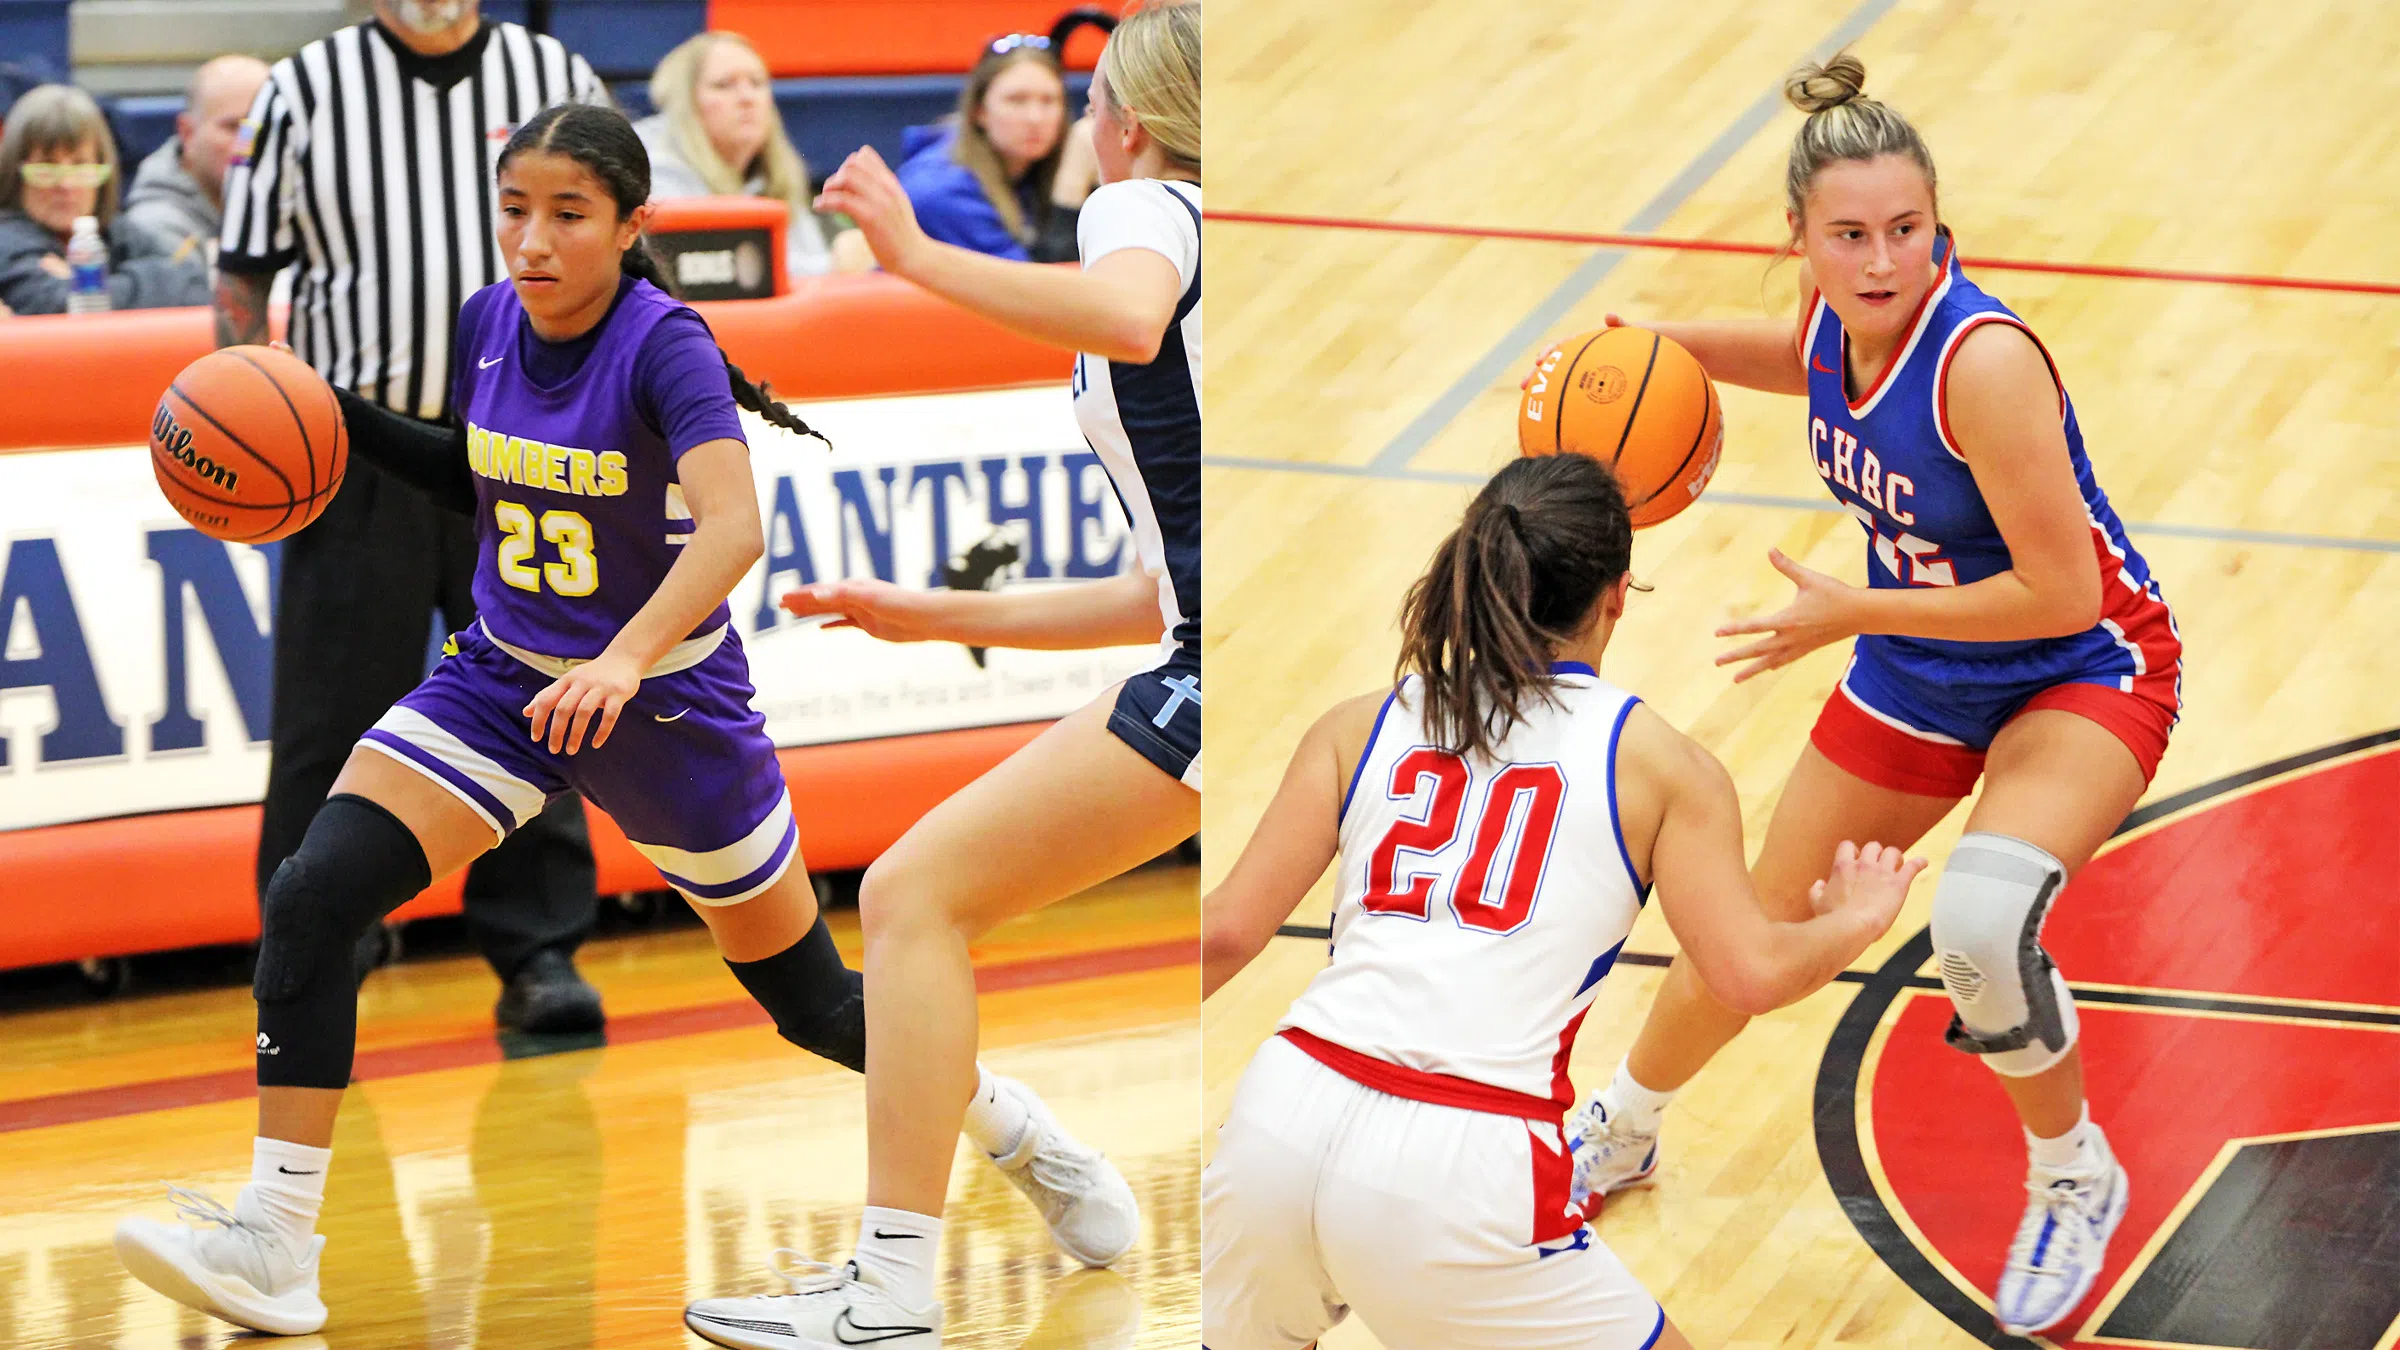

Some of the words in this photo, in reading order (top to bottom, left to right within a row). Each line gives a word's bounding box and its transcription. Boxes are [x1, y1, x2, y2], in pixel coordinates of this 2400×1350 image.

[153, 401, 239, 494] Wilson
[1811, 416, 1915, 526] CHBC
[495, 500, 599, 596] 23
[1358, 745, 1569, 937] 20
